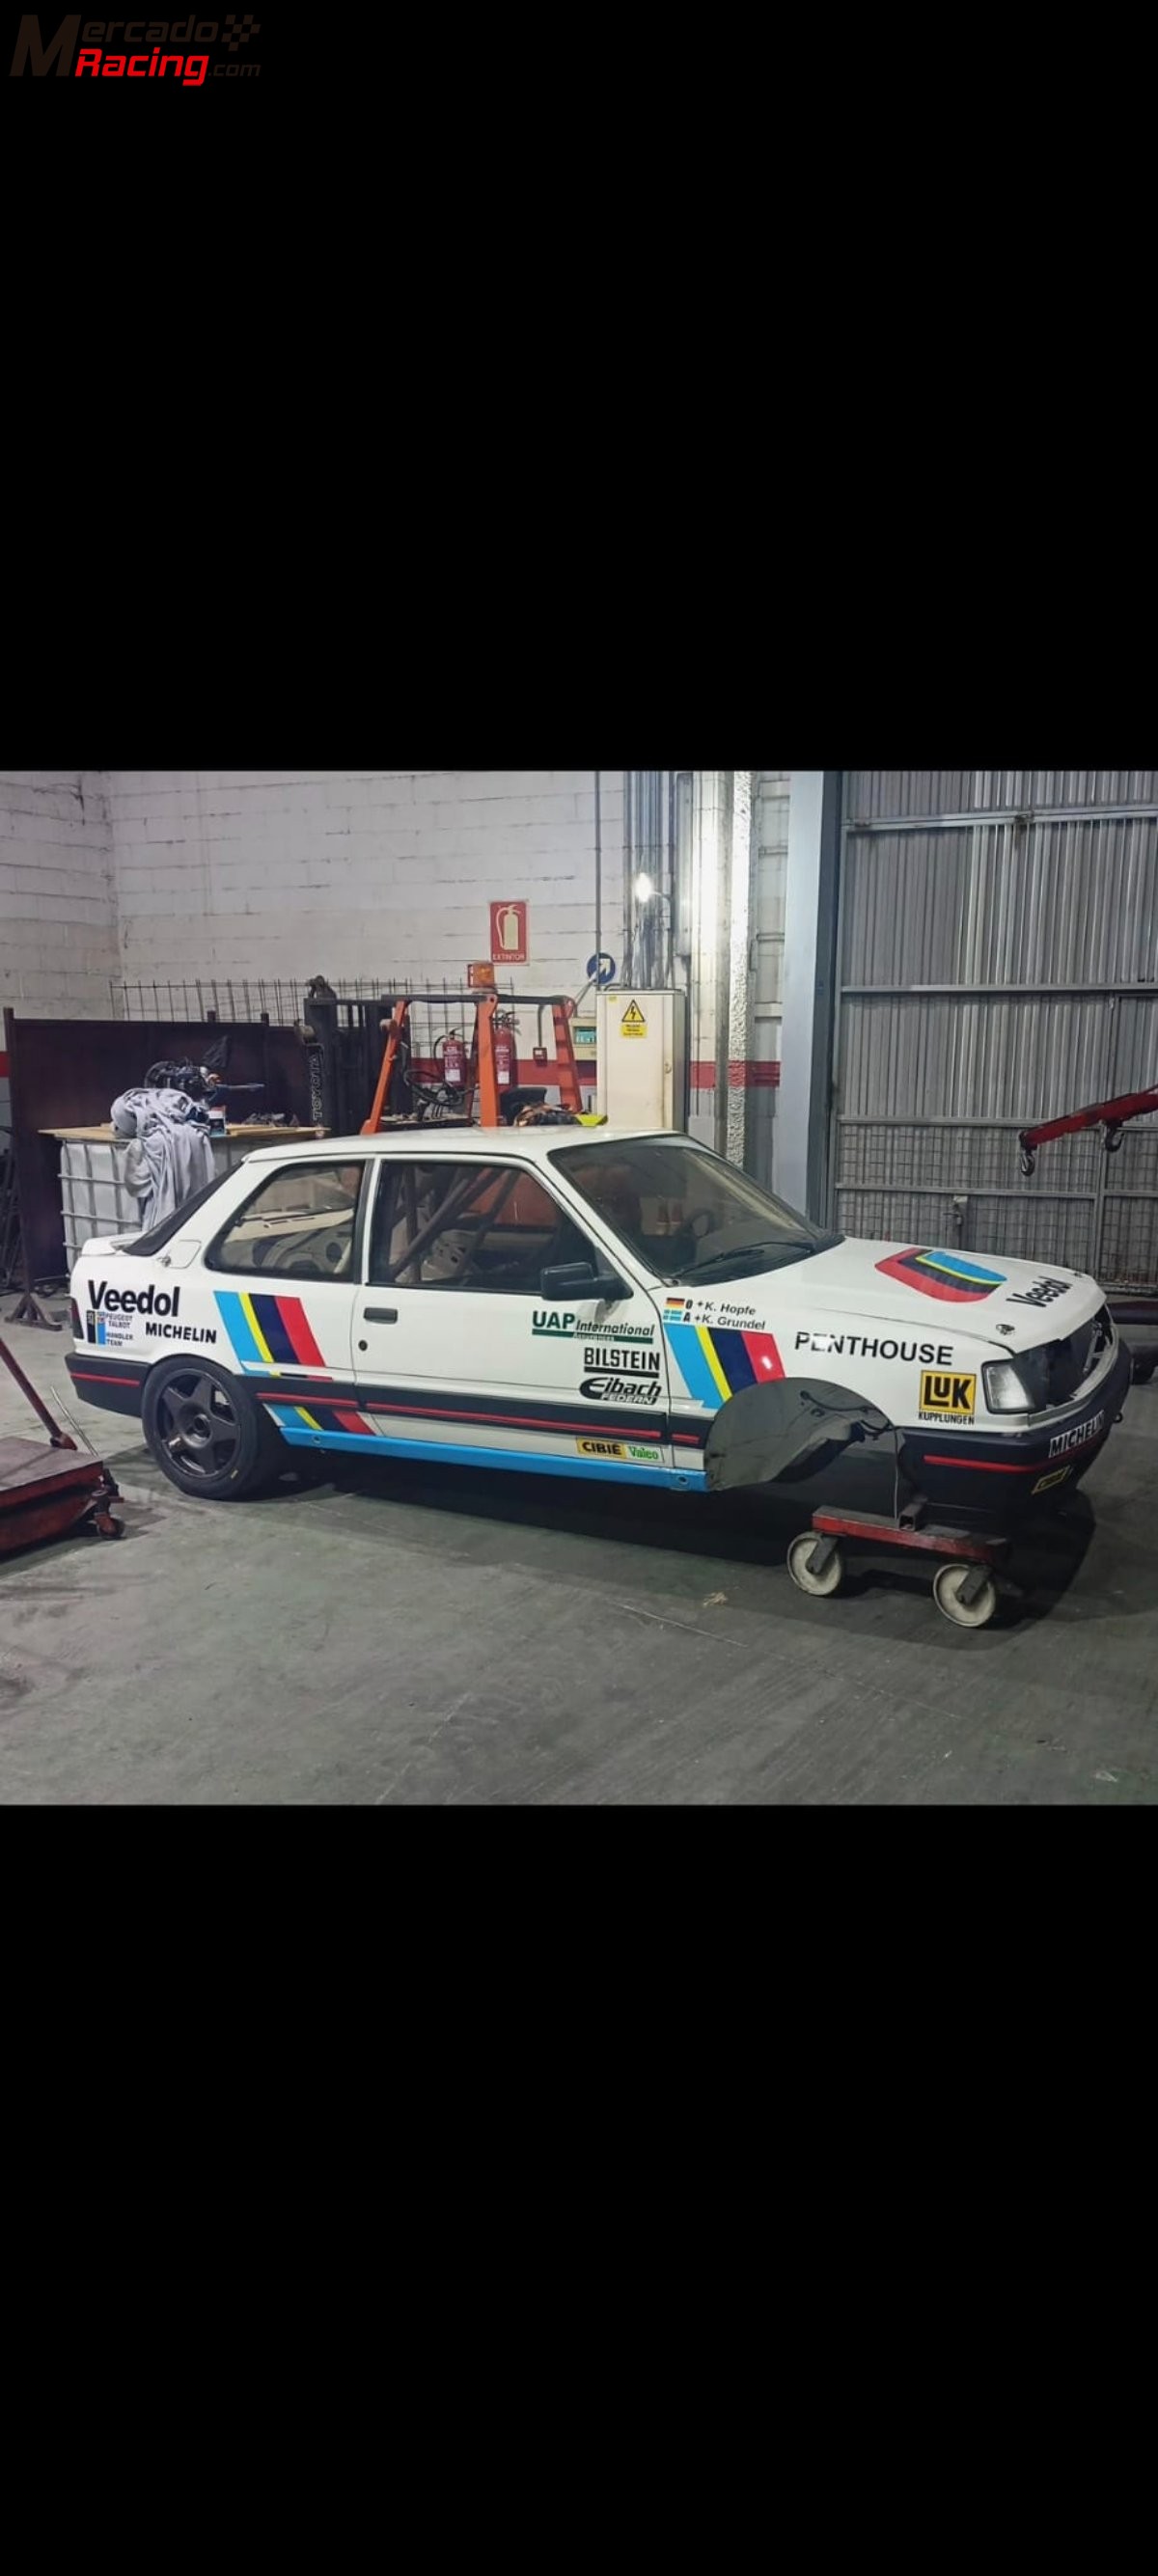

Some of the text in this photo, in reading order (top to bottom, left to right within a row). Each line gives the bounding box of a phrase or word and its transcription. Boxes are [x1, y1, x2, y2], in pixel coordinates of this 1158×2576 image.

[309, 1054, 323, 1121] TOYOTA
[88, 1279, 180, 1317] Veedol
[1006, 1275, 1073, 1307] Veedol
[533, 1310, 575, 1329] UAP
[720, 1303, 757, 1315] Hopfe
[145, 1322, 217, 1344] MICHELIN
[576, 1320, 655, 1336] International
[717, 1316, 765, 1329] Grundel
[584, 1347, 660, 1371] BILSTEIN
[794, 1331, 953, 1366] PENTHOUSE
[579, 1377, 662, 1400] Eibach
[600, 1392, 656, 1405] FEDERN
[919, 1411, 975, 1425] KUPPLUNGEN
